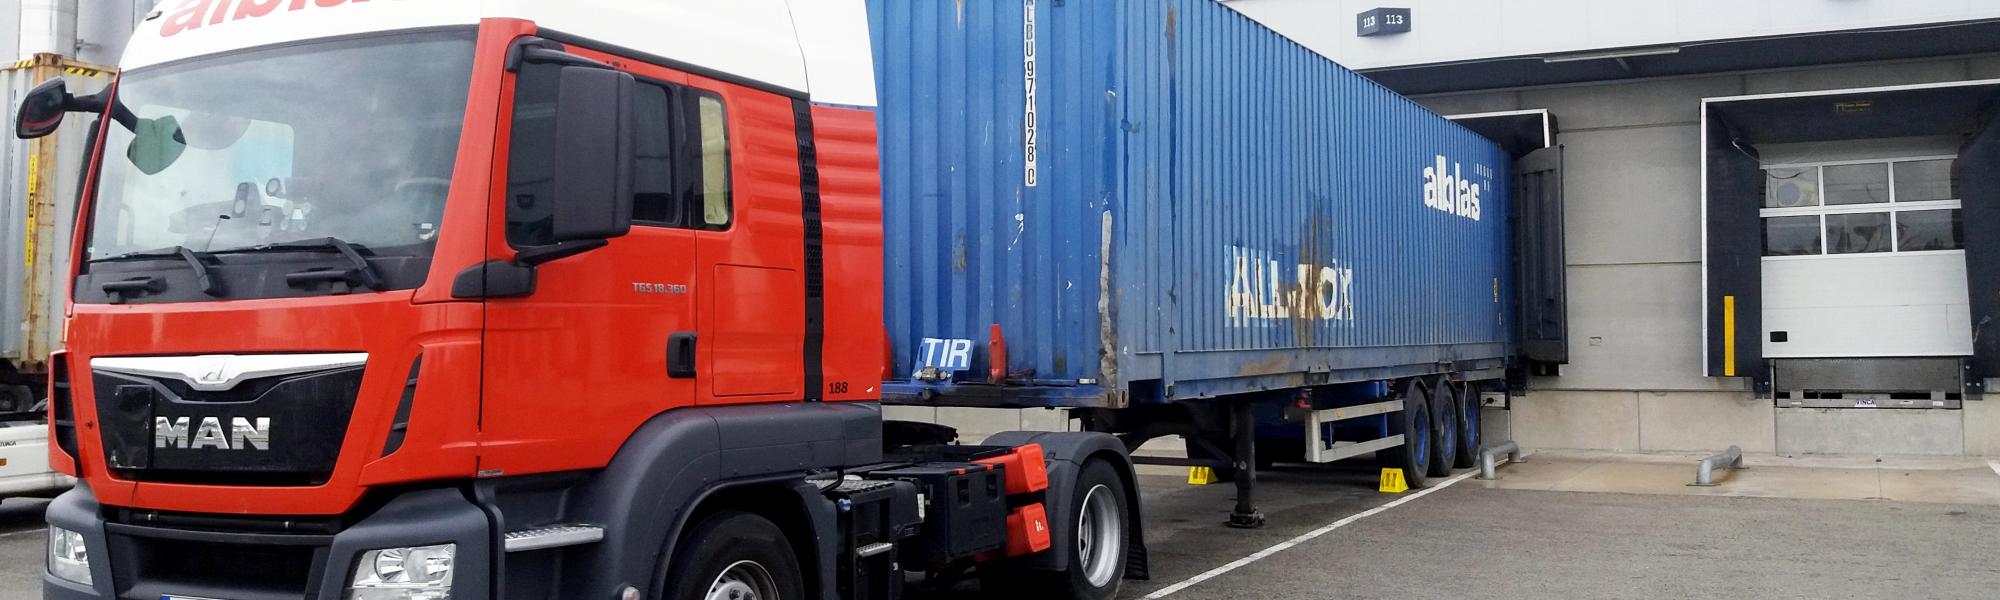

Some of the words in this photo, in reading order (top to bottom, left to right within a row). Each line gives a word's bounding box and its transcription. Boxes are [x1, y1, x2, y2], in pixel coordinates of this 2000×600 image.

[1363, 16, 1376, 28] 113
[1385, 14, 1403, 25] 113
[1026, 61, 1035, 162] 971028
[1423, 154, 1480, 221] alblas
[924, 337, 970, 368] TIR
[829, 381, 848, 394] 188
[155, 416, 271, 450] MAN
